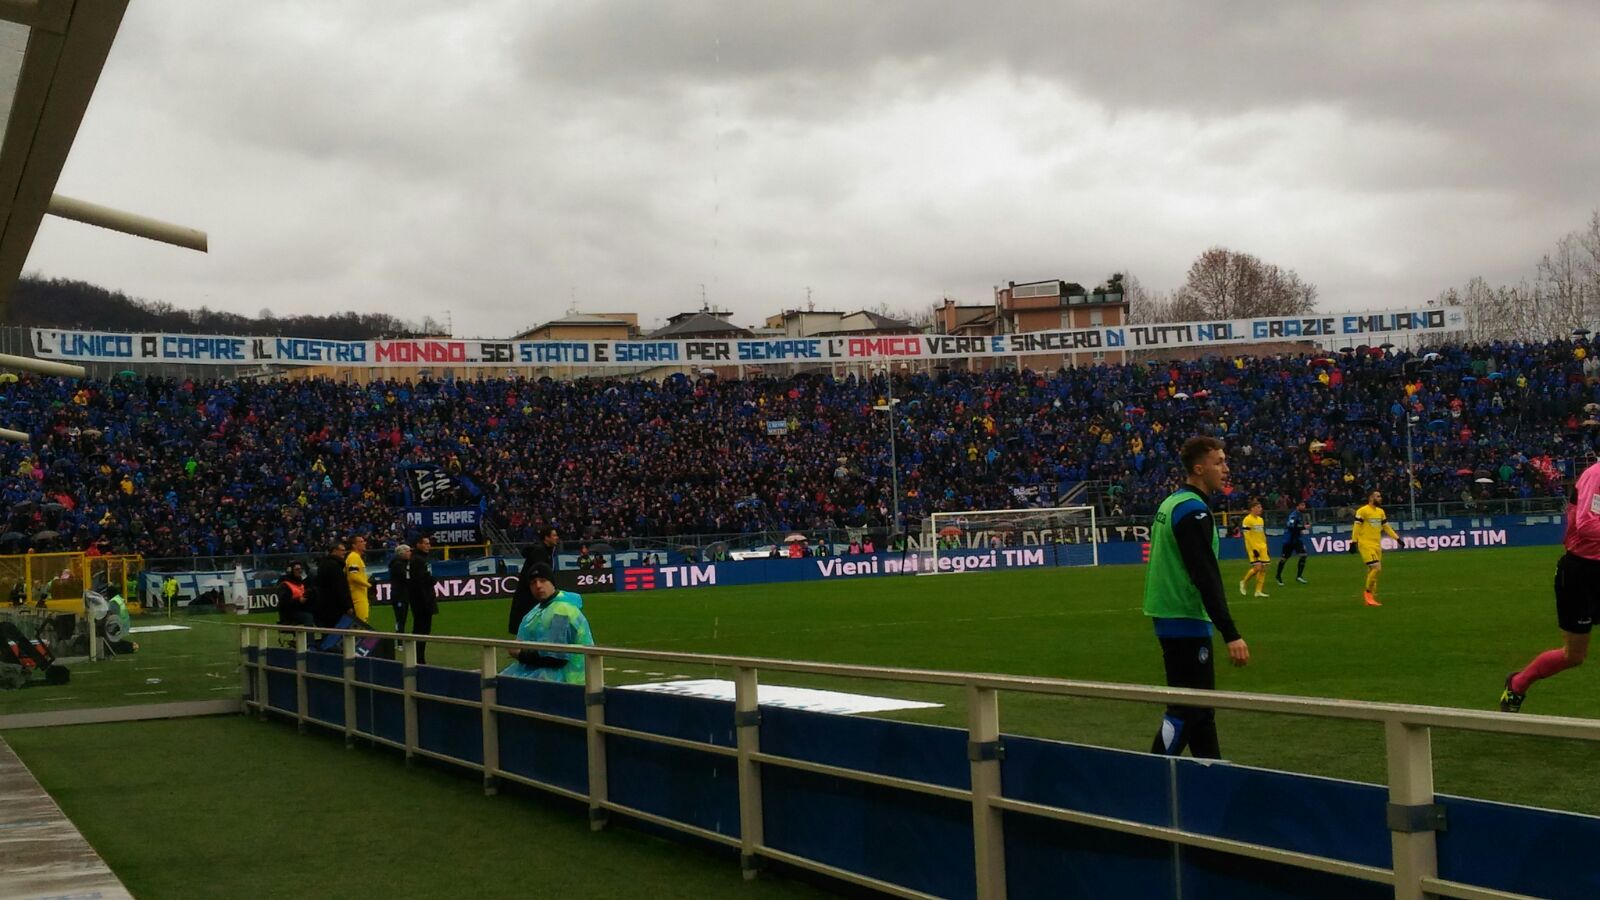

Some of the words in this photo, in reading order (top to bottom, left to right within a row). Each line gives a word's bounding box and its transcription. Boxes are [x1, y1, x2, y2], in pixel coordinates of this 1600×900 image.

[37, 331, 133, 357] L'UNICO
[141, 336, 157, 358] A
[162, 336, 246, 359] CAPIRE
[252, 338, 272, 360] IL
[276, 338, 366, 362] NOSTRO
[480, 343, 514, 362] SEI
[519, 343, 589, 362] STATO
[594, 343, 608, 362] E
[614, 343, 679, 361] SARAI
[685, 342, 730, 361] PER
[737, 339, 822, 360] SEMPRE
[828, 337, 921, 357] L'AMICO
[925, 336, 986, 355] VERO
[991, 335, 1005, 353] E
[1010, 330, 1101, 352] SINCERO
[1106, 328, 1124, 347] DI
[1130, 325, 1192, 345] TUTTI
[1252, 318, 1336, 339] GRAZIE
[1342, 310, 1445, 334] EMILIANO
[432, 510, 475, 525] SEMPRE
[434, 529, 476, 543] SEMPRE
[1403, 530, 1466, 552] negozi
[1469, 529, 1507, 546] TIM
[816, 555, 878, 577] Vieni
[884, 553, 918, 573] nei
[924, 550, 997, 573] negozi
[1001, 548, 1044, 566] TIM
[576, 573, 614, 586] 26:41
[659, 564, 716, 587] TIM
